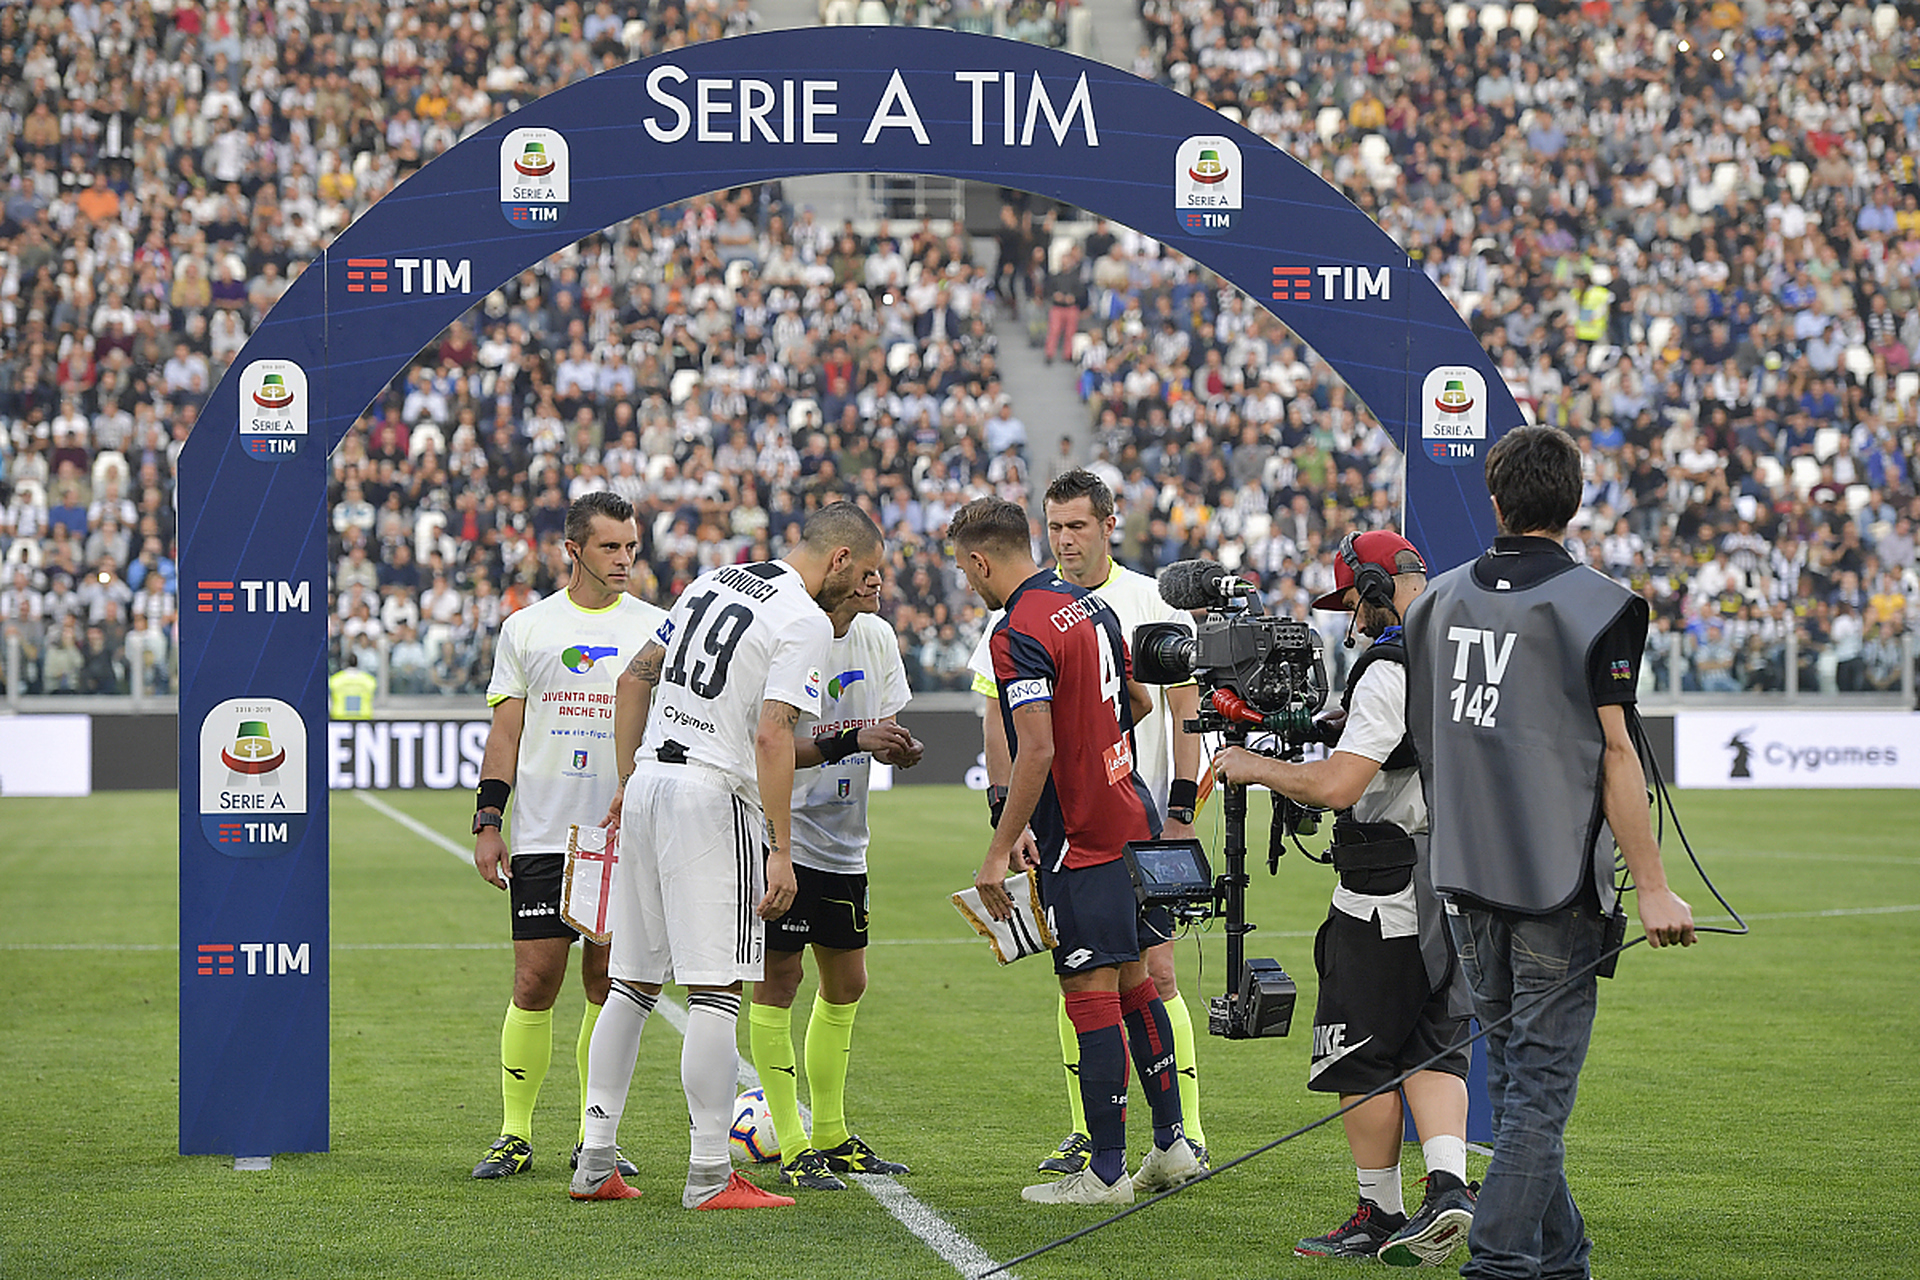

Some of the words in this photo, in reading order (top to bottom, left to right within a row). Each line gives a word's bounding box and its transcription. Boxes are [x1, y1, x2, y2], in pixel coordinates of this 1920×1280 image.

[643, 65, 838, 143] SERIE
[862, 68, 931, 145] A
[955, 69, 1099, 147] TIM
[513, 187, 542, 199] SERIE
[545, 188, 556, 199] A
[1187, 194, 1215, 206] SERIE
[1218, 195, 1229, 206] A
[529, 207, 557, 221] TIM
[1202, 213, 1230, 228] TIM
[394, 258, 471, 294] TIM
[1317, 266, 1390, 300] TIM
[252, 419, 281, 431] SERIE
[284, 420, 295, 431] A
[1433, 424, 1461, 436] SERIE
[1463, 425, 1474, 436] A
[268, 439, 296, 453] TIM
[1448, 443, 1475, 458] TIM
[240, 581, 310, 612] TIM
[665, 590, 754, 700] 19
[1447, 626, 1517, 685] TV
[1095, 622, 1121, 722] 4
[559, 706, 595, 718] ANCHE
[598, 708, 612, 719] TU
[1450, 683, 1499, 728] 142
[1764, 741, 1898, 772] Cygames
[219, 791, 265, 809] SERIE
[270, 792, 286, 809] A
[244, 823, 288, 843] TIM
[240, 943, 310, 975] TIM
